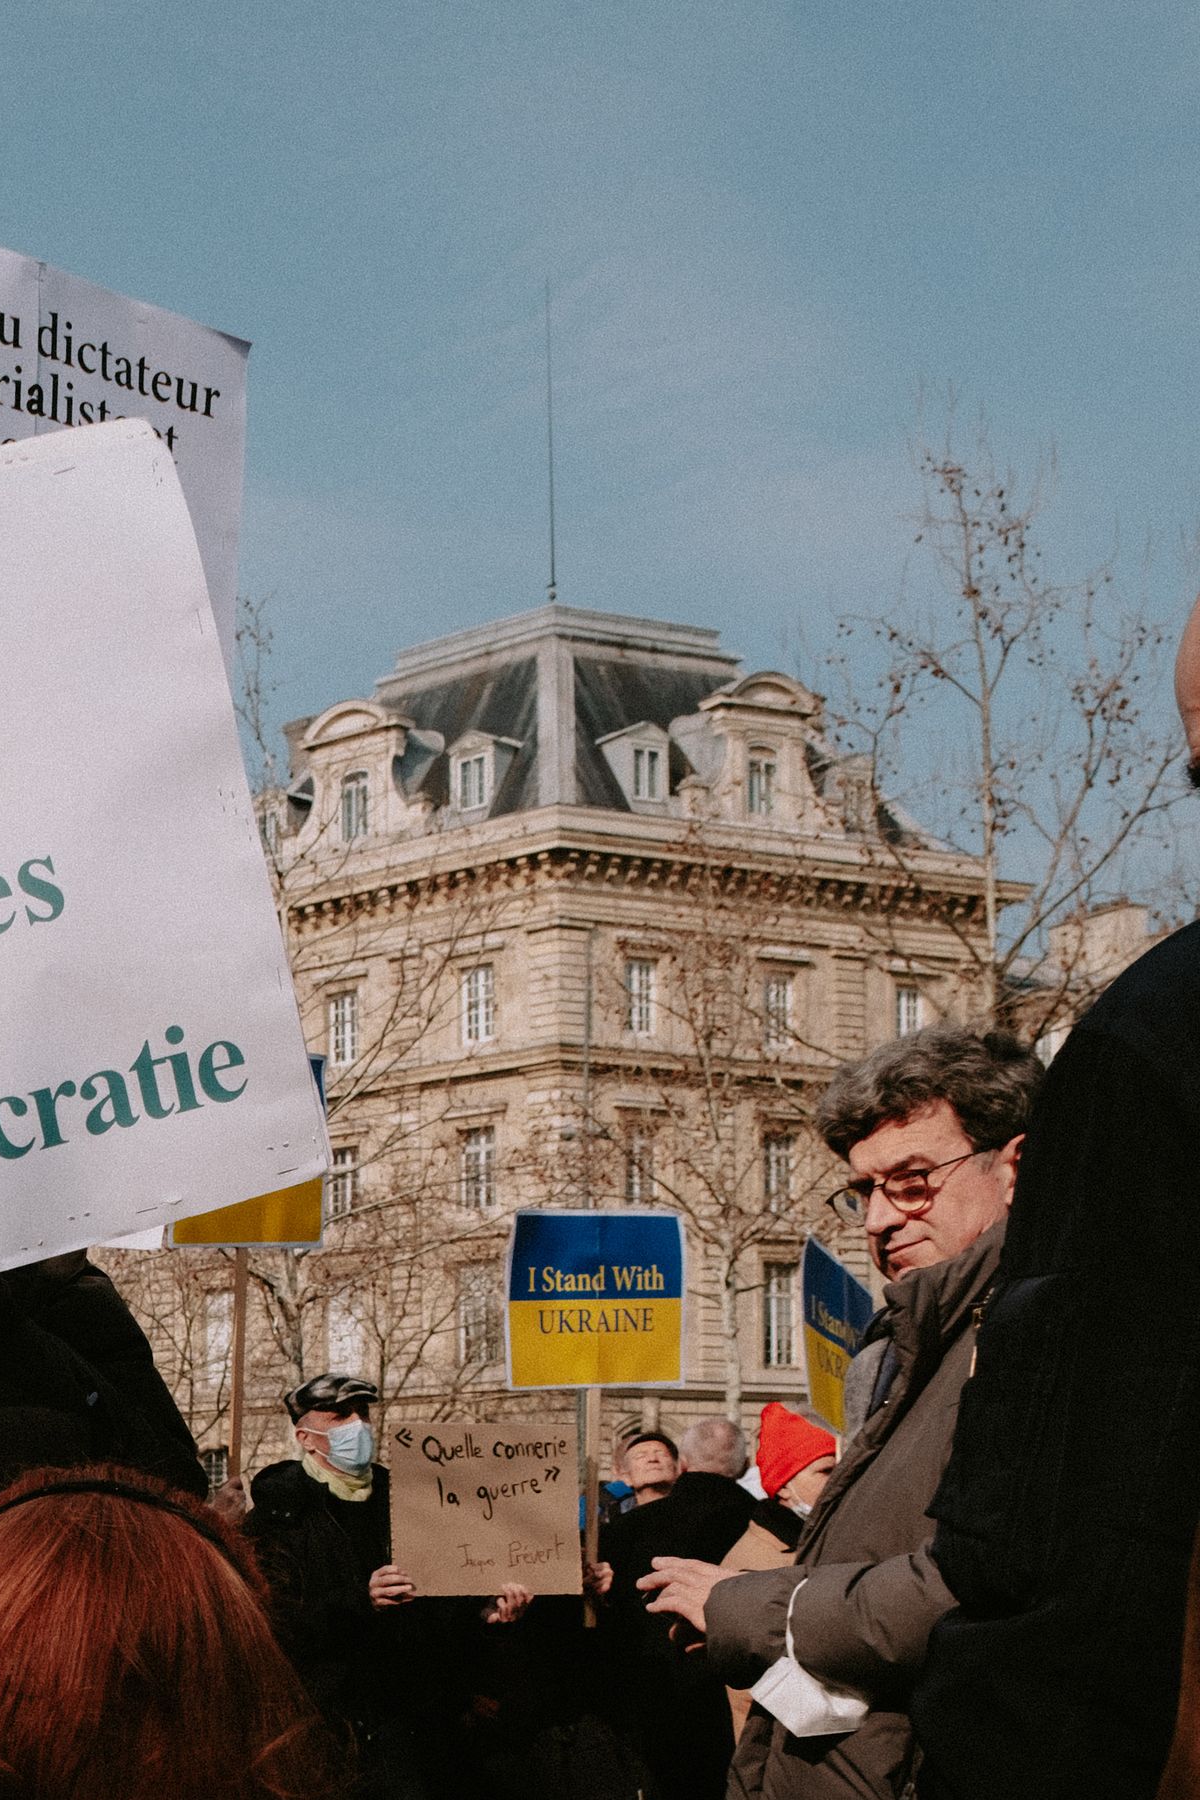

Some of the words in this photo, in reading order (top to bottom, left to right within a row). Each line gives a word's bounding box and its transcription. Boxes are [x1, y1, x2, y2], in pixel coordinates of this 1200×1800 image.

[37, 312, 221, 418] dictateur
[528, 1267, 536, 1292] I
[542, 1265, 605, 1292] Stand
[611, 1264, 665, 1292] With
[538, 1308, 655, 1334] UKRAINE
[422, 1433, 484, 1467] Quelle
[492, 1436, 568, 1460] connerie
[436, 1476, 460, 1508] la
[508, 1533, 565, 1568] Prévert
